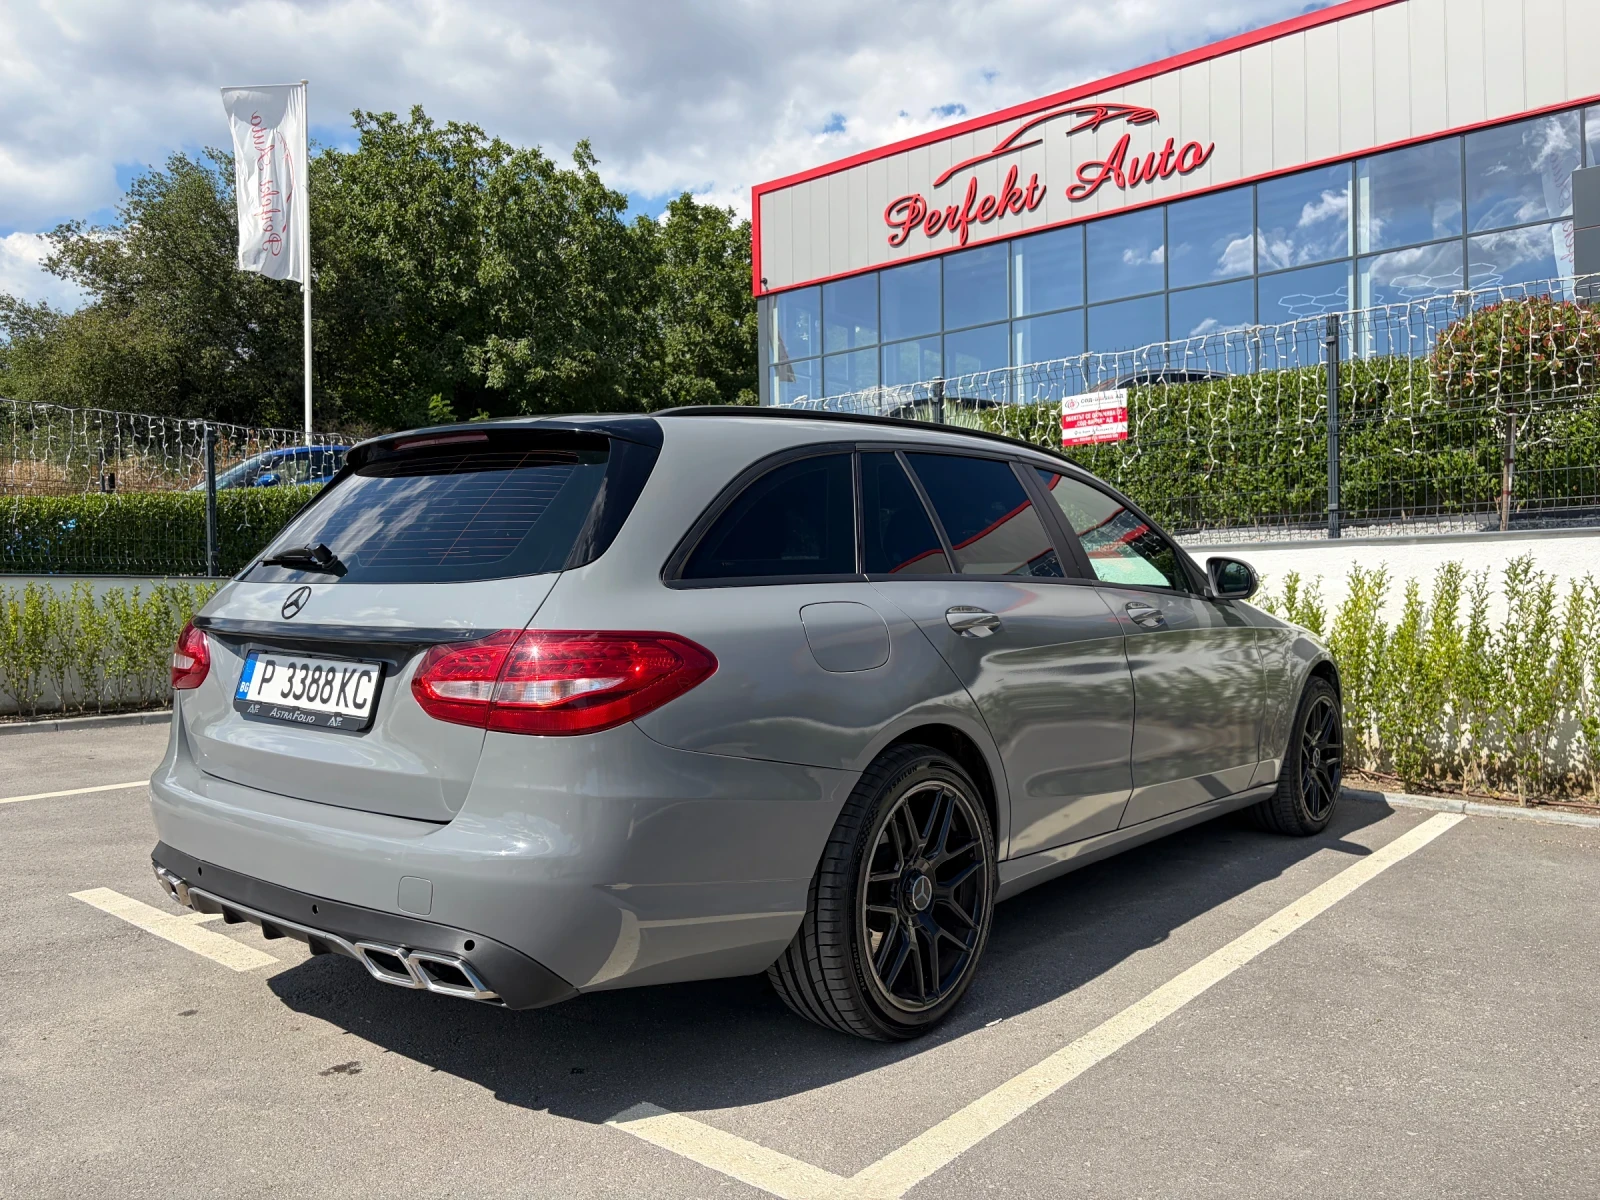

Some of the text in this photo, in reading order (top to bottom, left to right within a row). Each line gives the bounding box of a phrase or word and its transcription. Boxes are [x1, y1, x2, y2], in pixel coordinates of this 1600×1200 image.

[883, 133, 1215, 246] Perfekt Auto
[239, 681, 250, 693] BG
[257, 659, 277, 696] P
